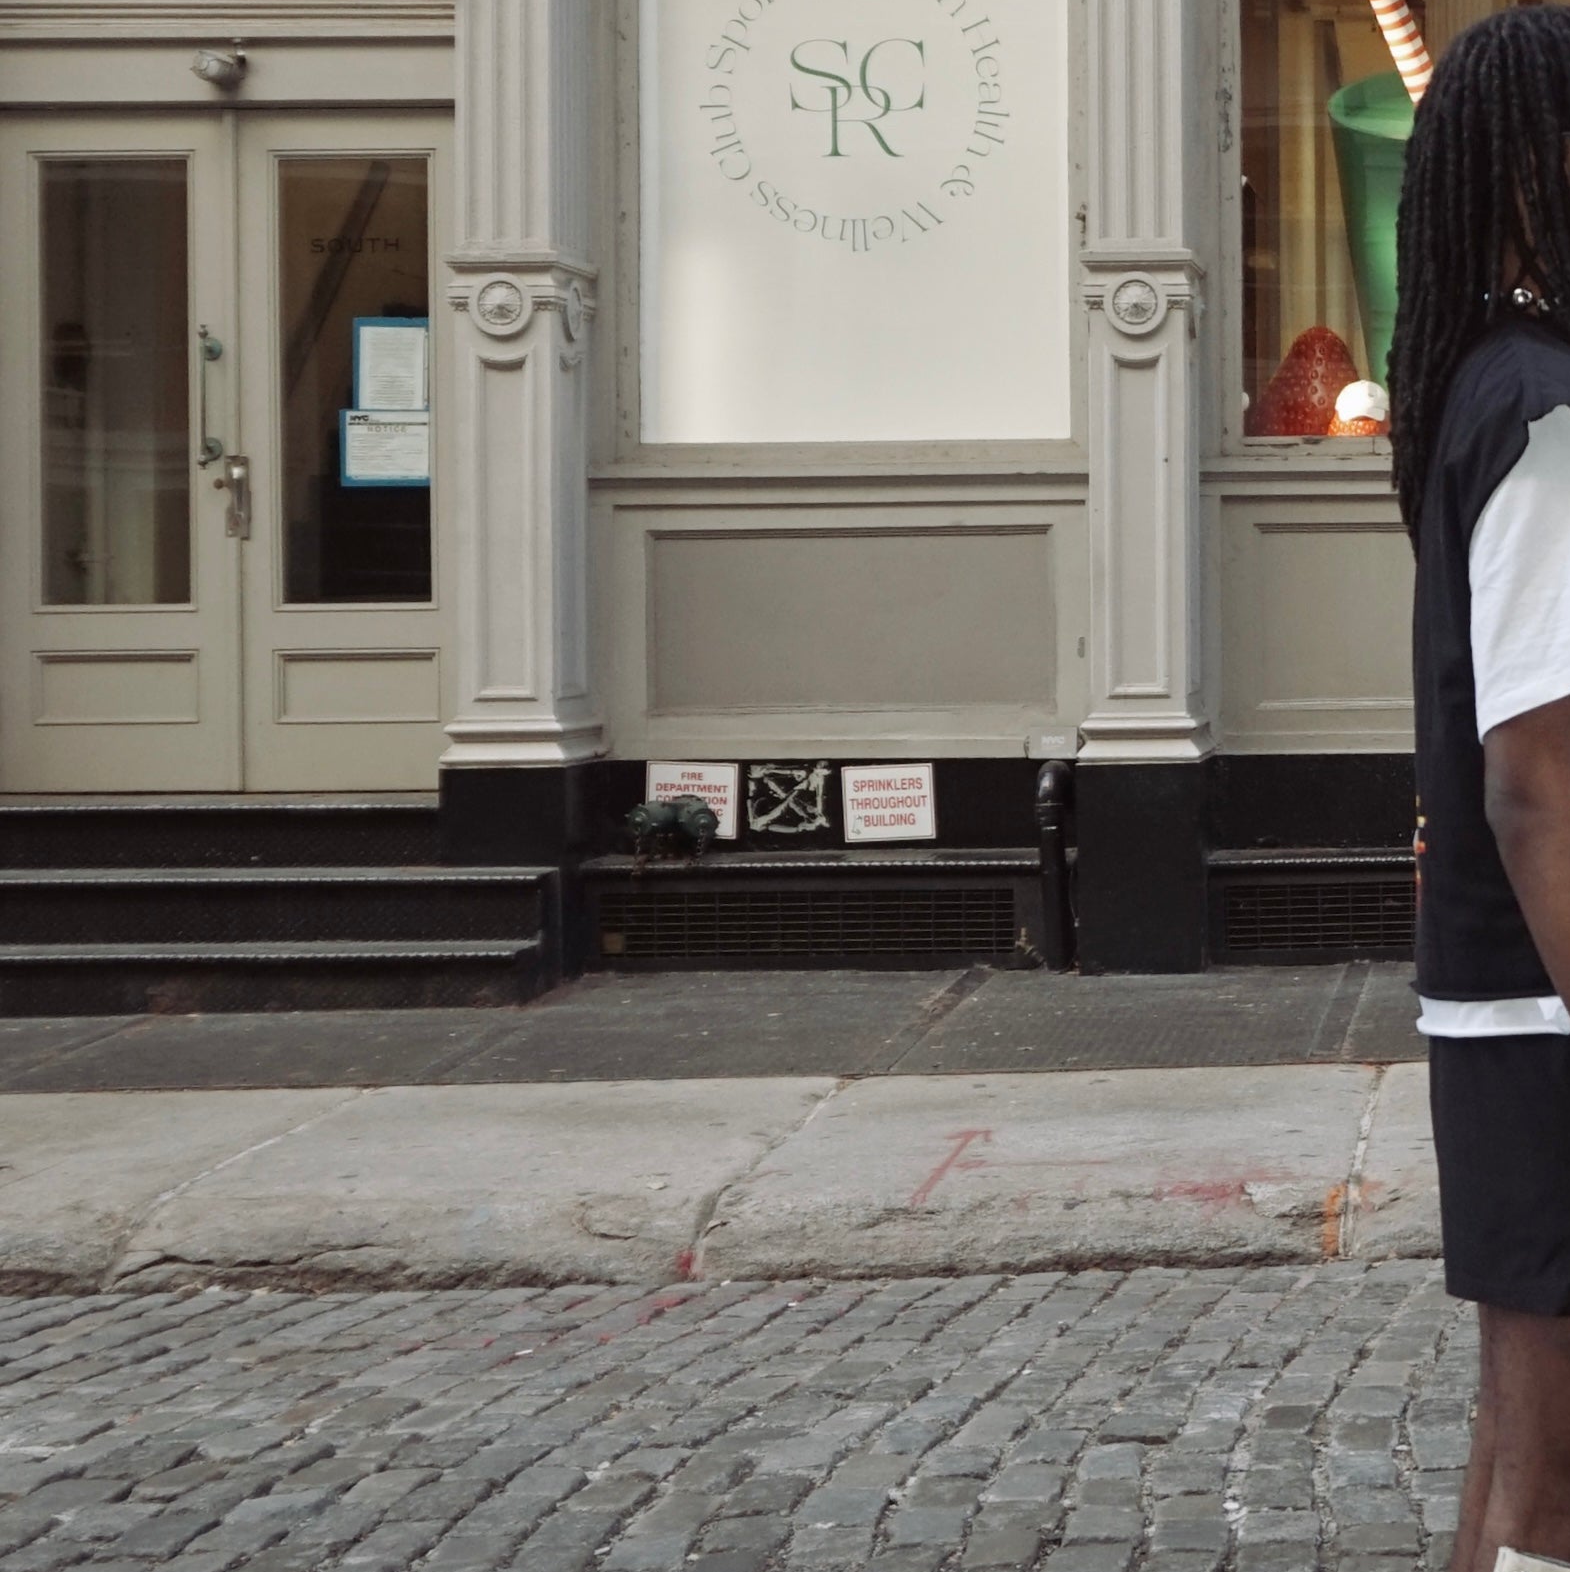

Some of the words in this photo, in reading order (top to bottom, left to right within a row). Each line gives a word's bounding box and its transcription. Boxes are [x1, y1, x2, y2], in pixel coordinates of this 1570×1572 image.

[961, 16, 1010, 158] Health
[699, 83, 752, 181] Club
[940, 164, 975, 198] &
[750, 181, 945, 253] Wellness
[310, 237, 400, 254] SOUTH
[681, 771, 704, 781] FIRE
[655, 782, 728, 794] DEPARTMENT
[853, 777, 923, 793] SPRINKLERS
[655, 794, 728, 805] COTION
[849, 795, 927, 810] THROUGHOUT
[863, 812, 916, 828] BUILDING
